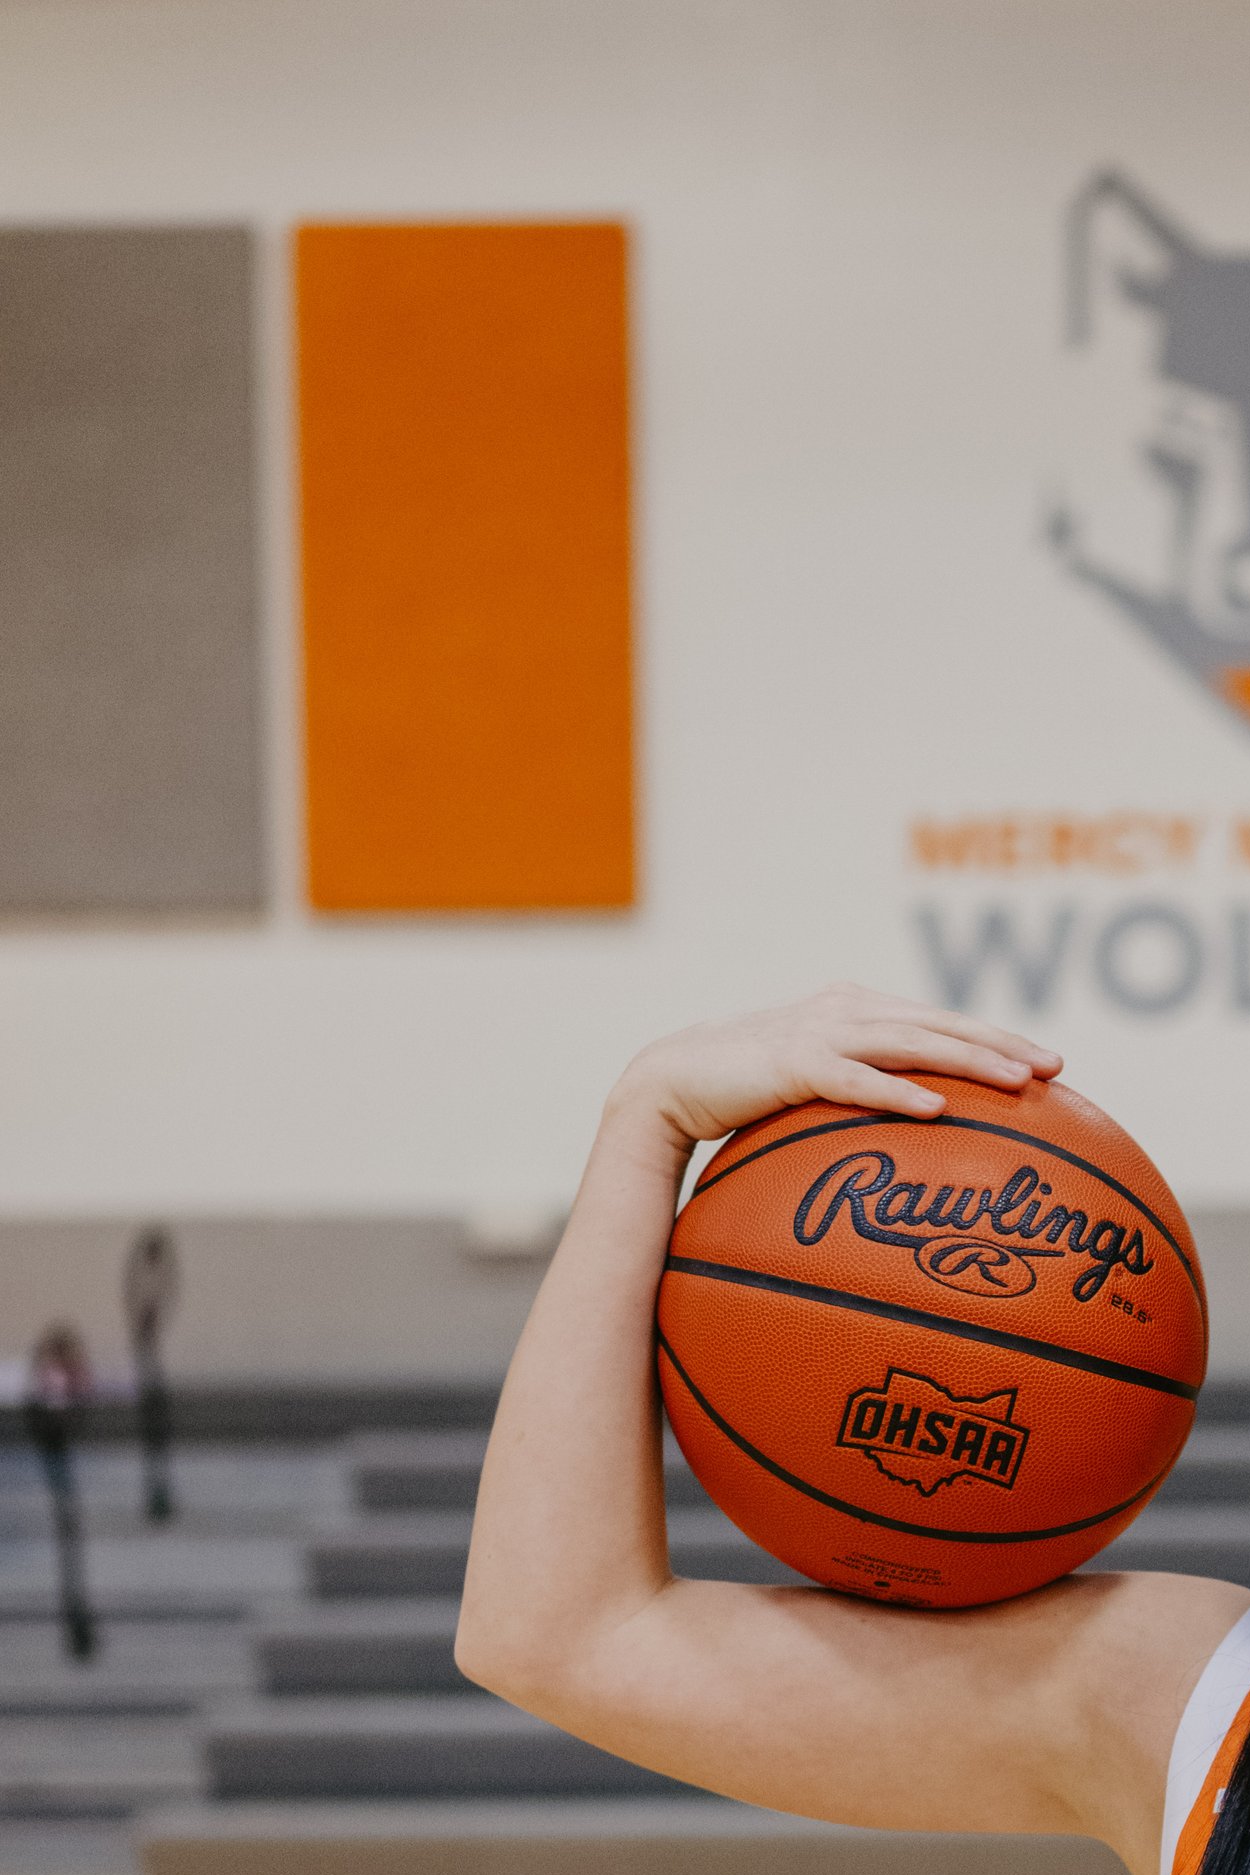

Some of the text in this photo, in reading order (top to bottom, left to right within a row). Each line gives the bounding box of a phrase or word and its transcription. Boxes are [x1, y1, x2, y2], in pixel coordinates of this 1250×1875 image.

[910, 814, 1199, 872] MERCY
[793, 1151, 1154, 1302] Rawlings
[851, 1399, 1017, 1476] OHSAA
